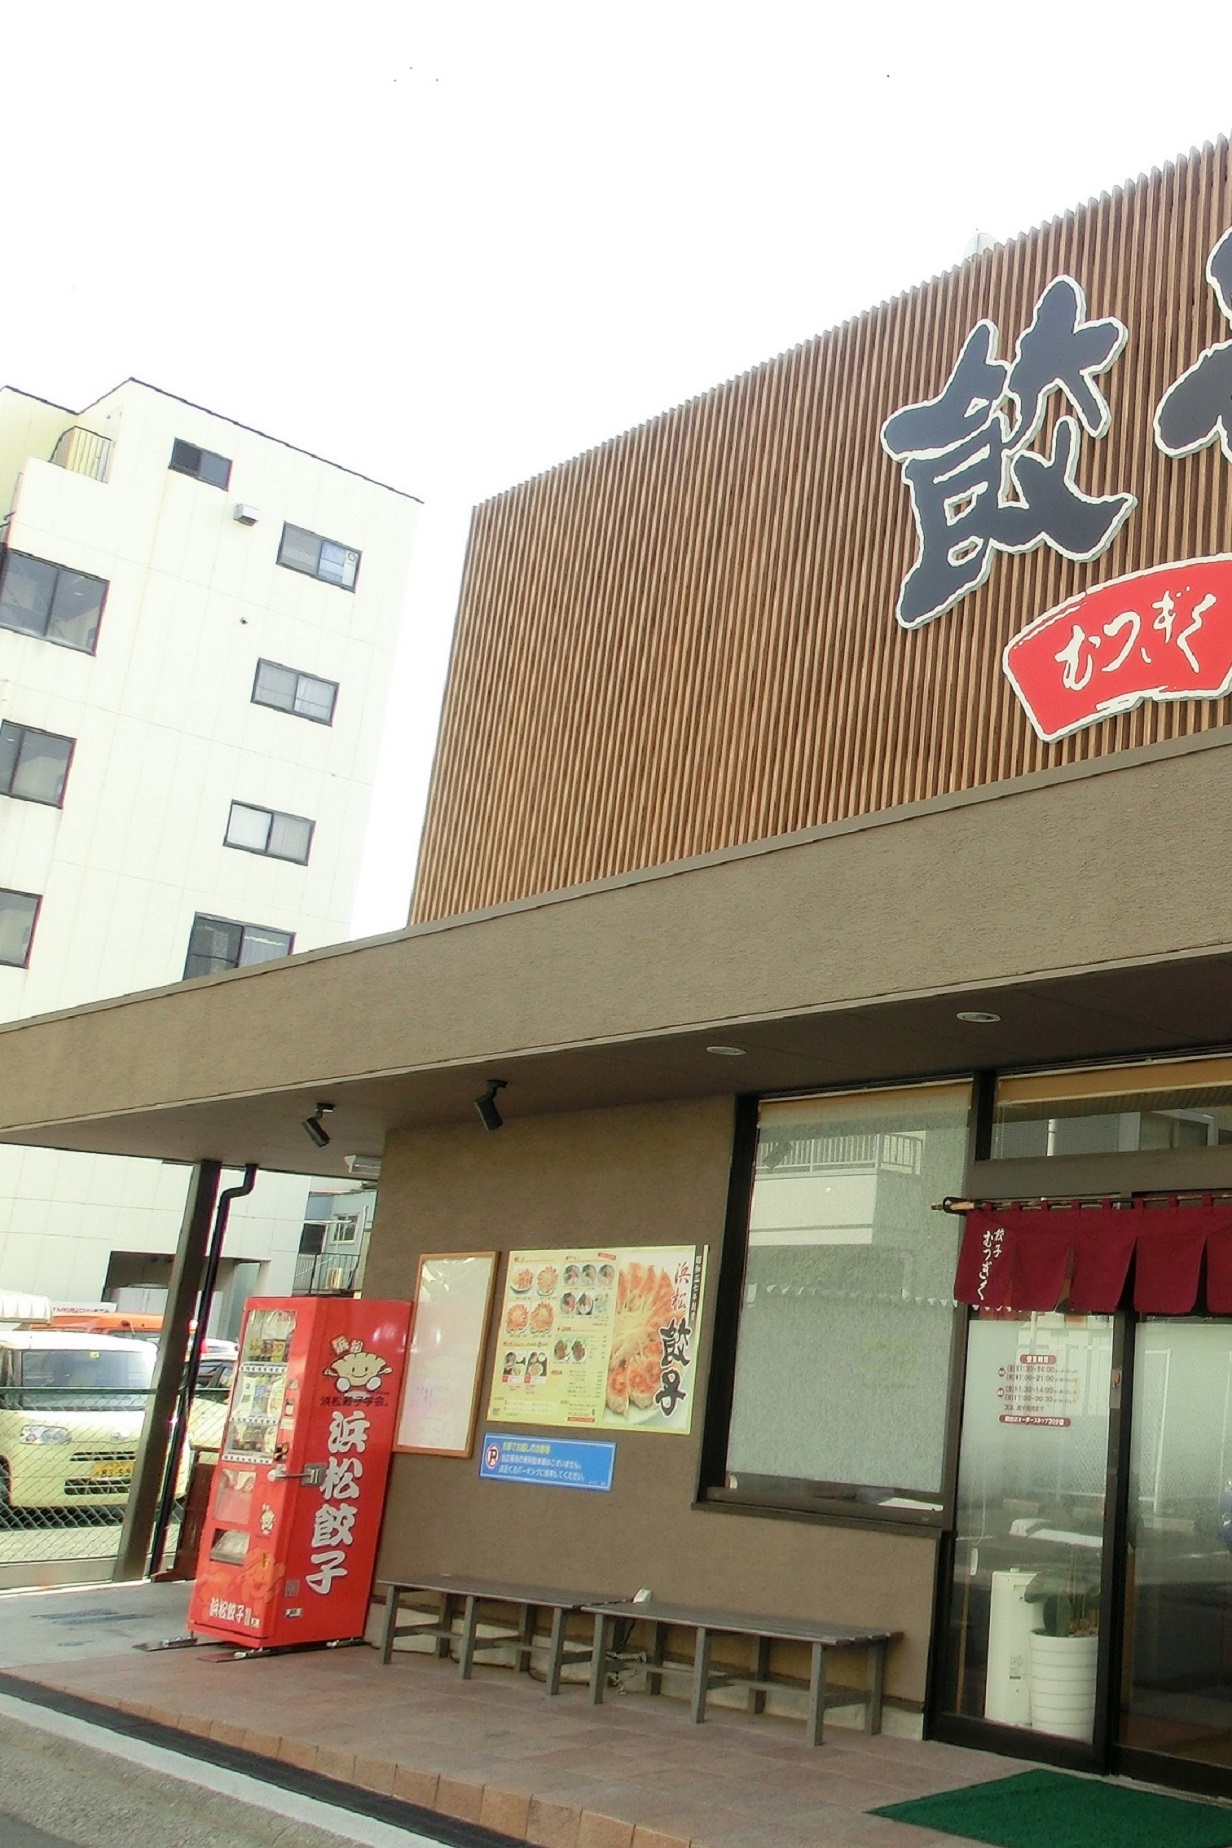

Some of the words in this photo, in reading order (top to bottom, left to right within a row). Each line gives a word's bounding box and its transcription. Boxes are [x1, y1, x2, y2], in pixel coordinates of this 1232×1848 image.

[1055, 586, 1217, 690] むつぎく
[977, 1230, 993, 1301] むつぎく
[306, 1411, 371, 1594] 浜松餃子
